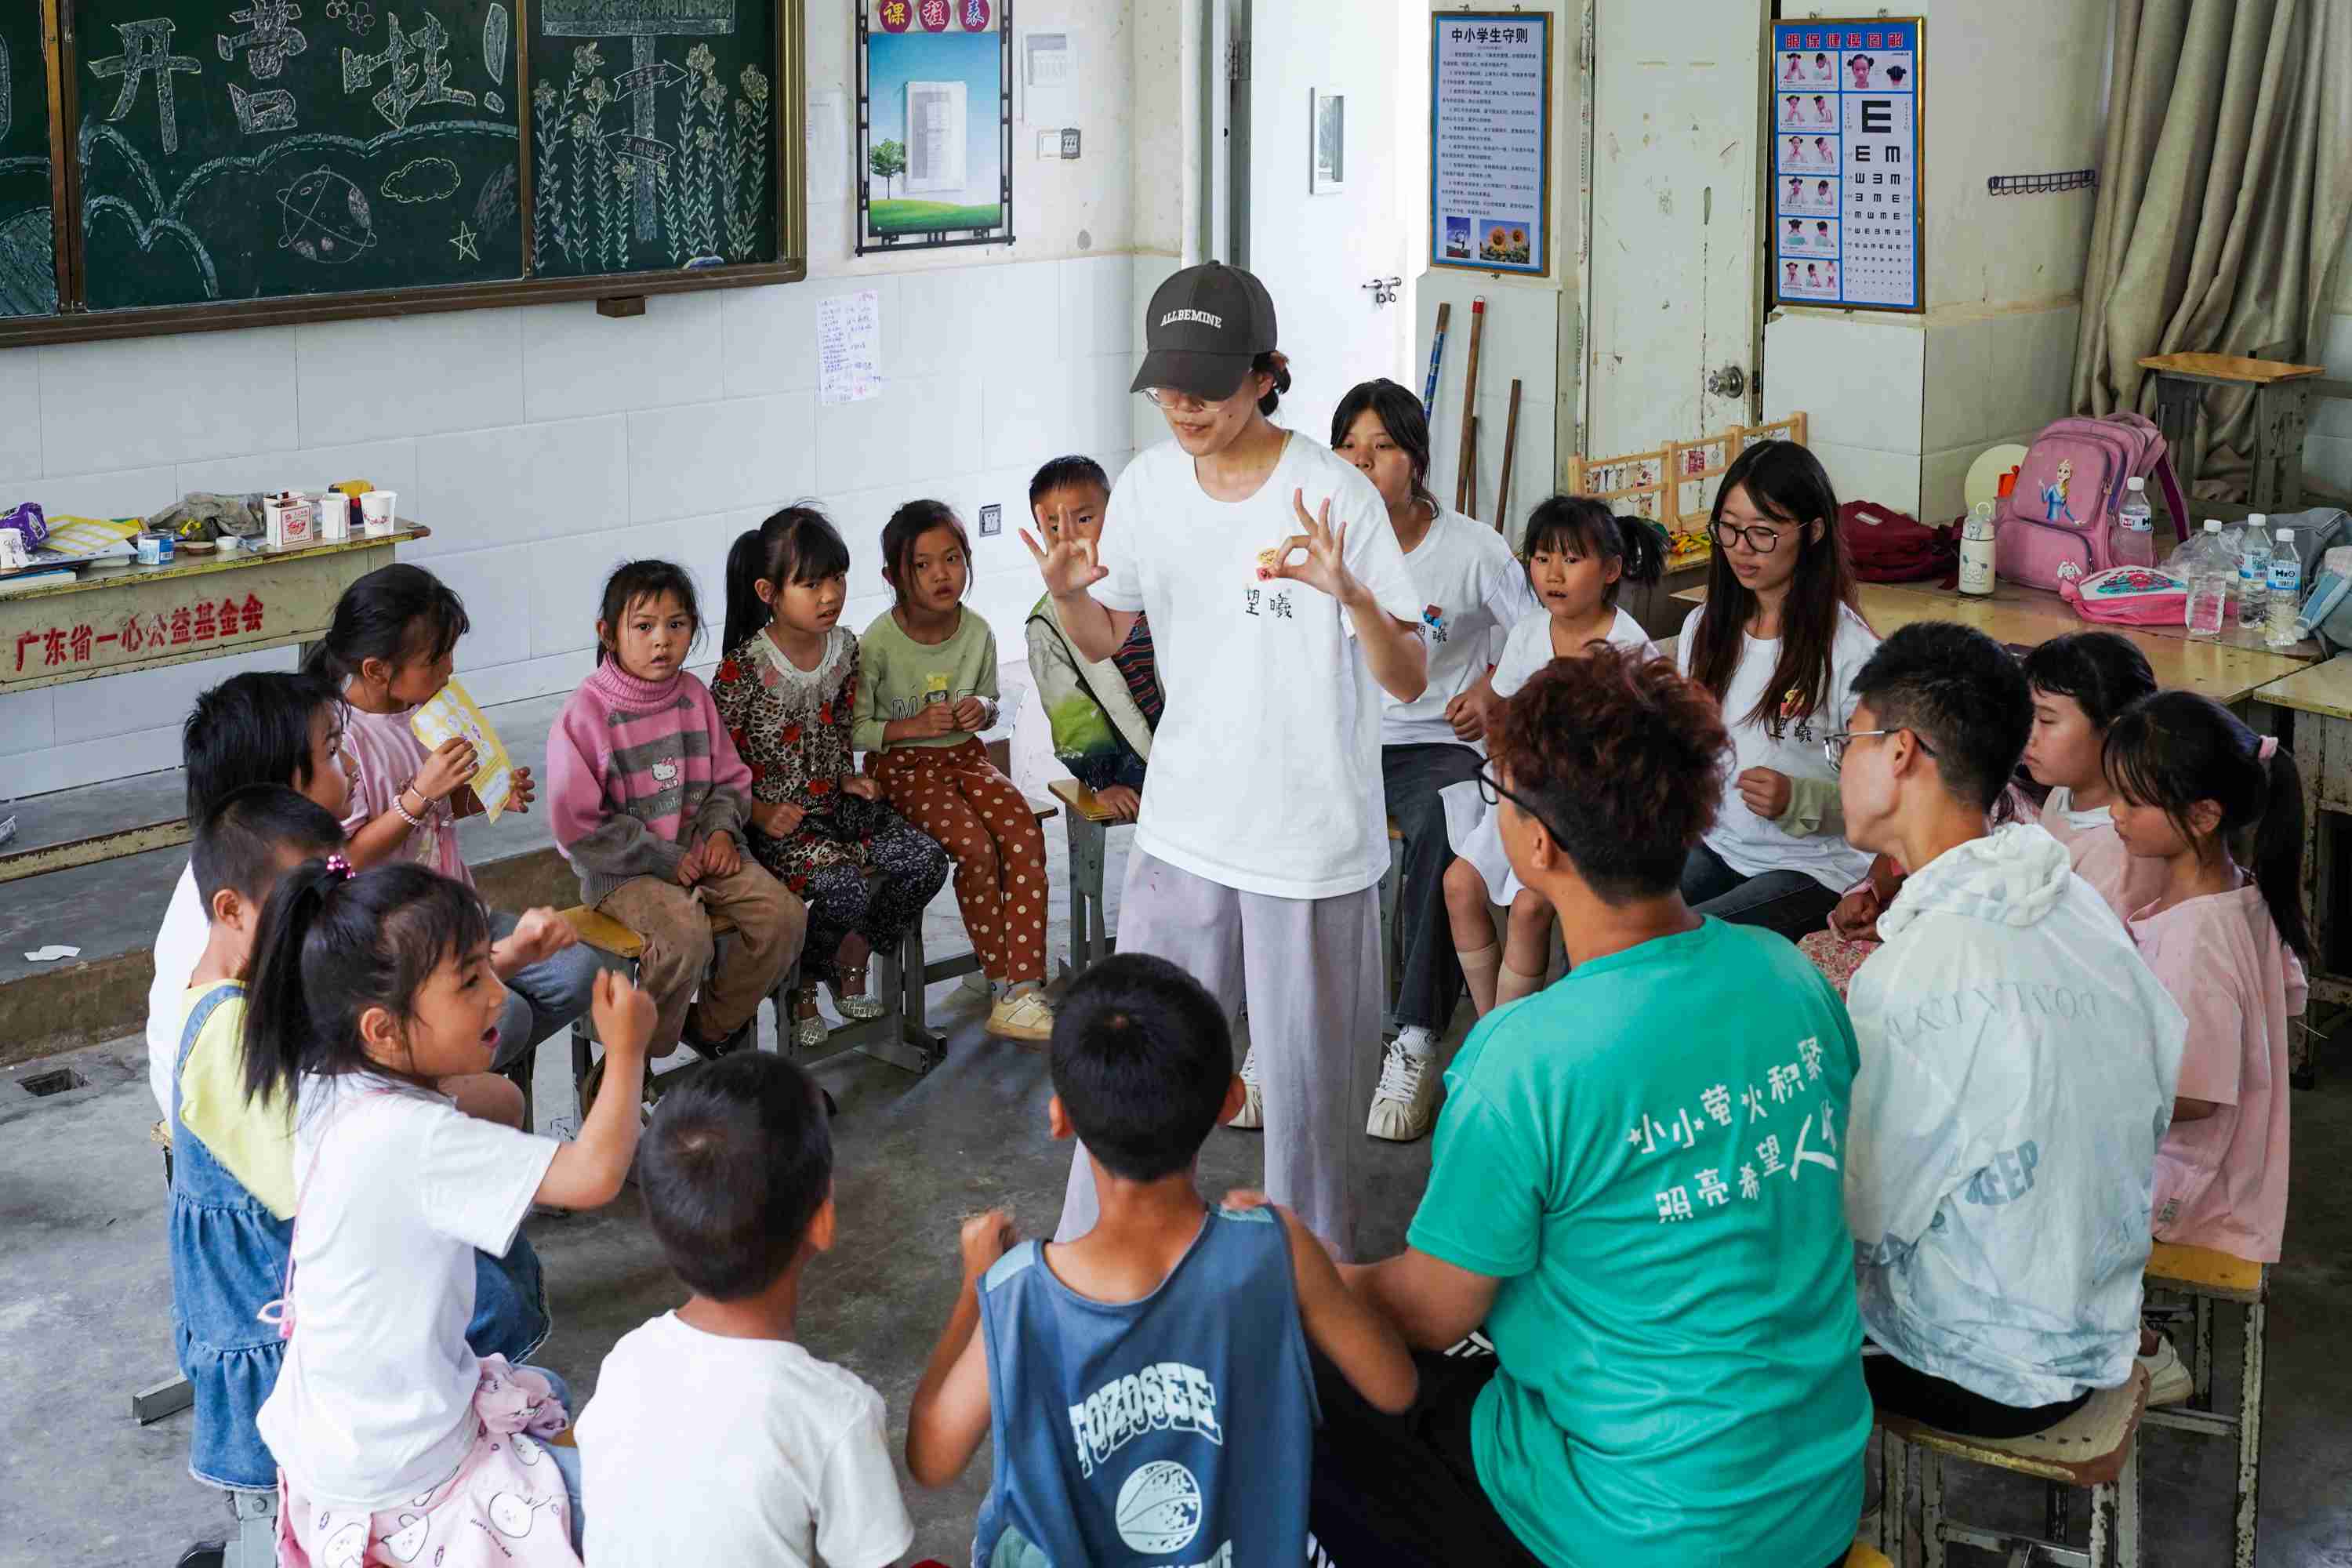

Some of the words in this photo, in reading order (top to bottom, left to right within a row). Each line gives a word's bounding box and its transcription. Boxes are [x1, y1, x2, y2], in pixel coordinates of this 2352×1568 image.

[883, 1, 985, 26] 课程表
[1451, 28, 1528, 43] 中小学生守则
[1160, 310, 1222, 328] ALLBEMINE
[16, 592, 264, 672] 广东省一心公益基金会
